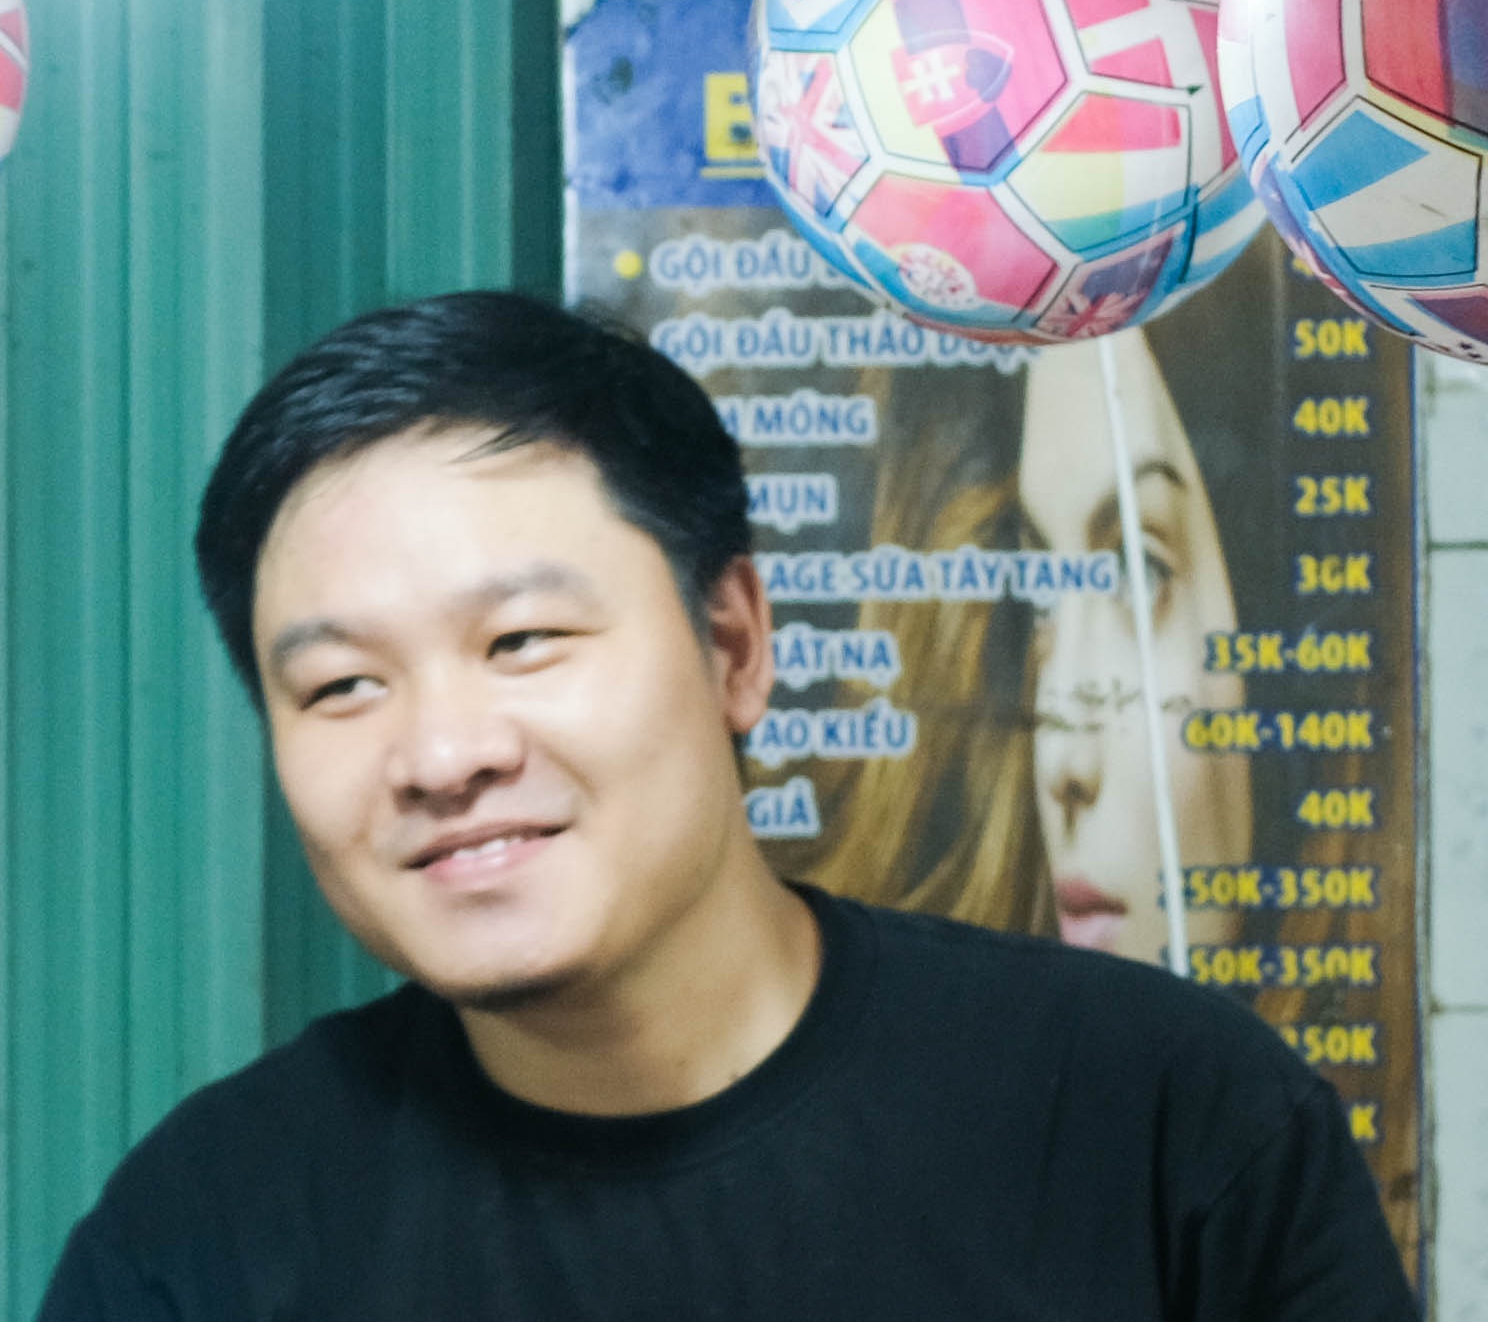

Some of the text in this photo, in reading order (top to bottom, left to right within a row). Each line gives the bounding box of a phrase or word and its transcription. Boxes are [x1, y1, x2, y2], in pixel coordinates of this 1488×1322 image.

[1295, 320, 1368, 358] 50K
[1293, 398, 1369, 436] 40K
[1295, 478, 1370, 515] 25K
[1186, 711, 1372, 749] 60K-140K
[1298, 789, 1373, 827] 40K
[1166, 869, 1375, 907] 50K-350K
[1174, 946, 1375, 984] 50K-350K
